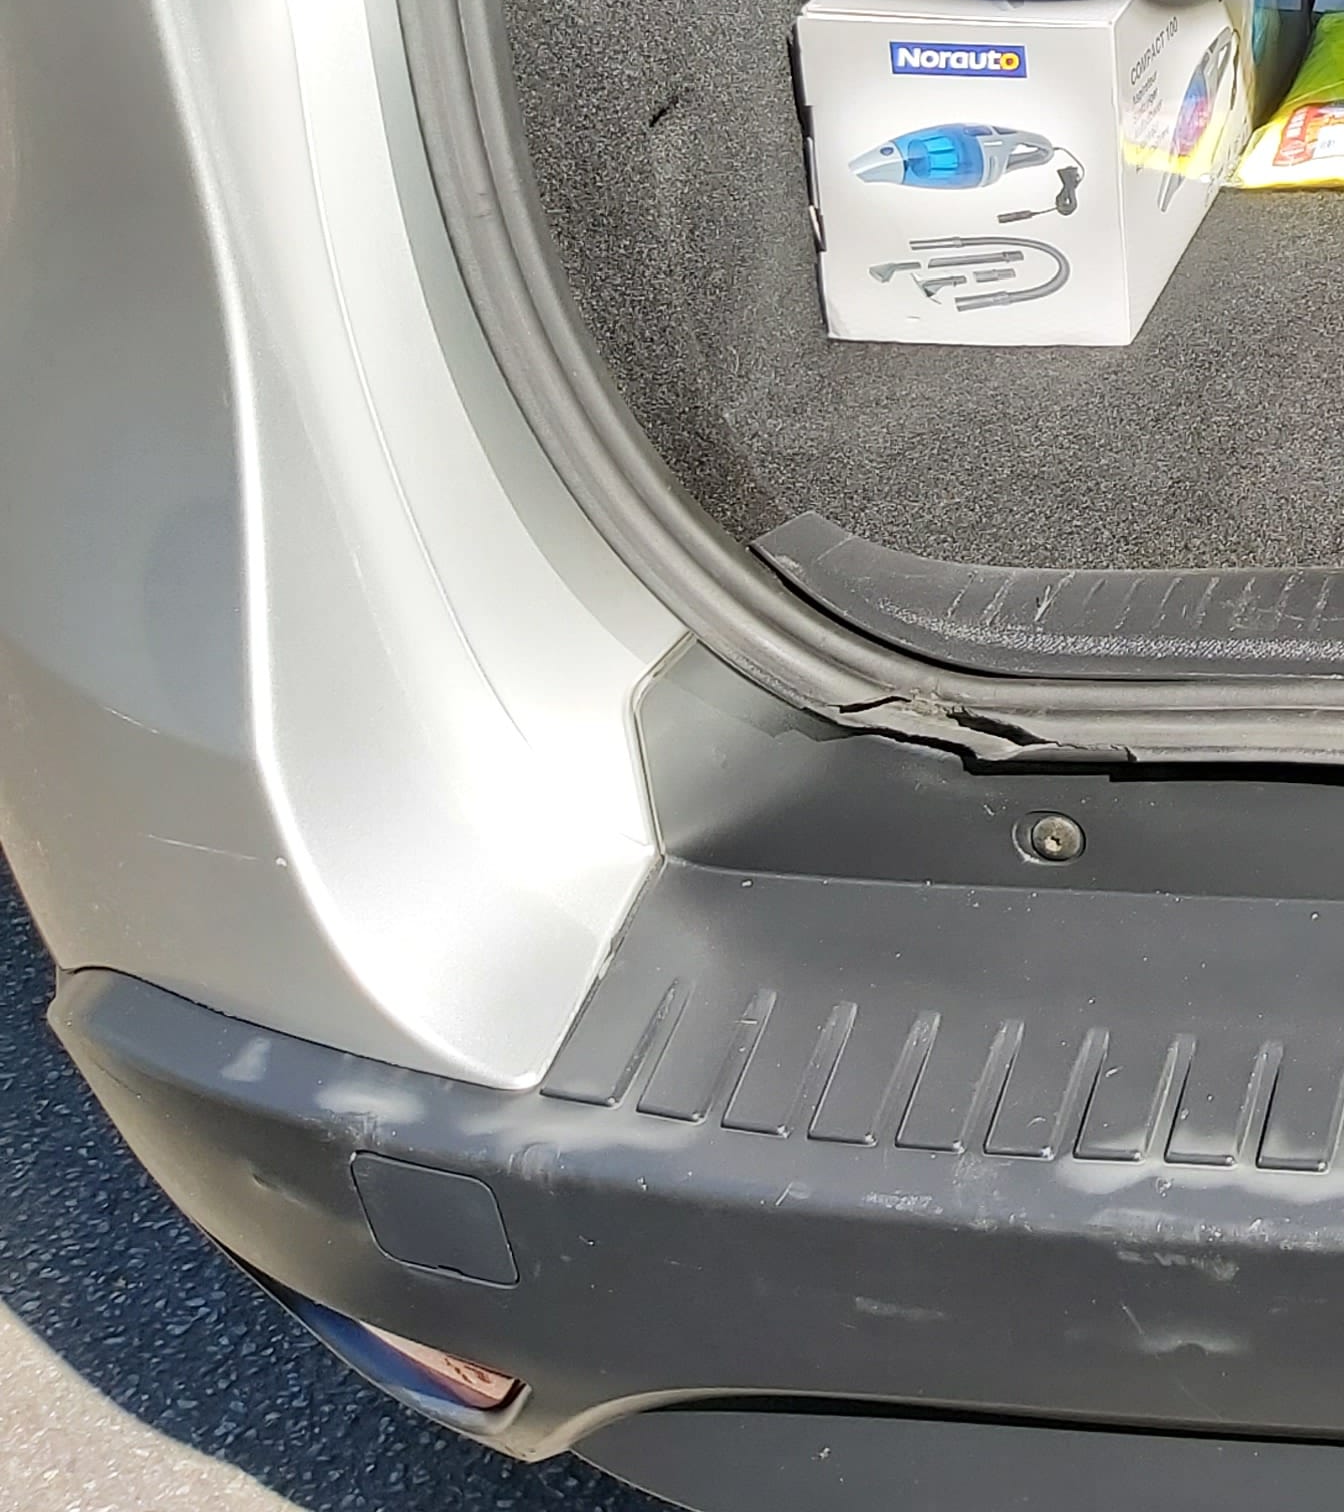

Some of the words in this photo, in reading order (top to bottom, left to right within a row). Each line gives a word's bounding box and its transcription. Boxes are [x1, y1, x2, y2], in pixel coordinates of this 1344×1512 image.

[897, 47, 1020, 71] Norauto
[1130, 30, 1165, 86] COMPACT
[1166, 15, 1179, 41] 100
